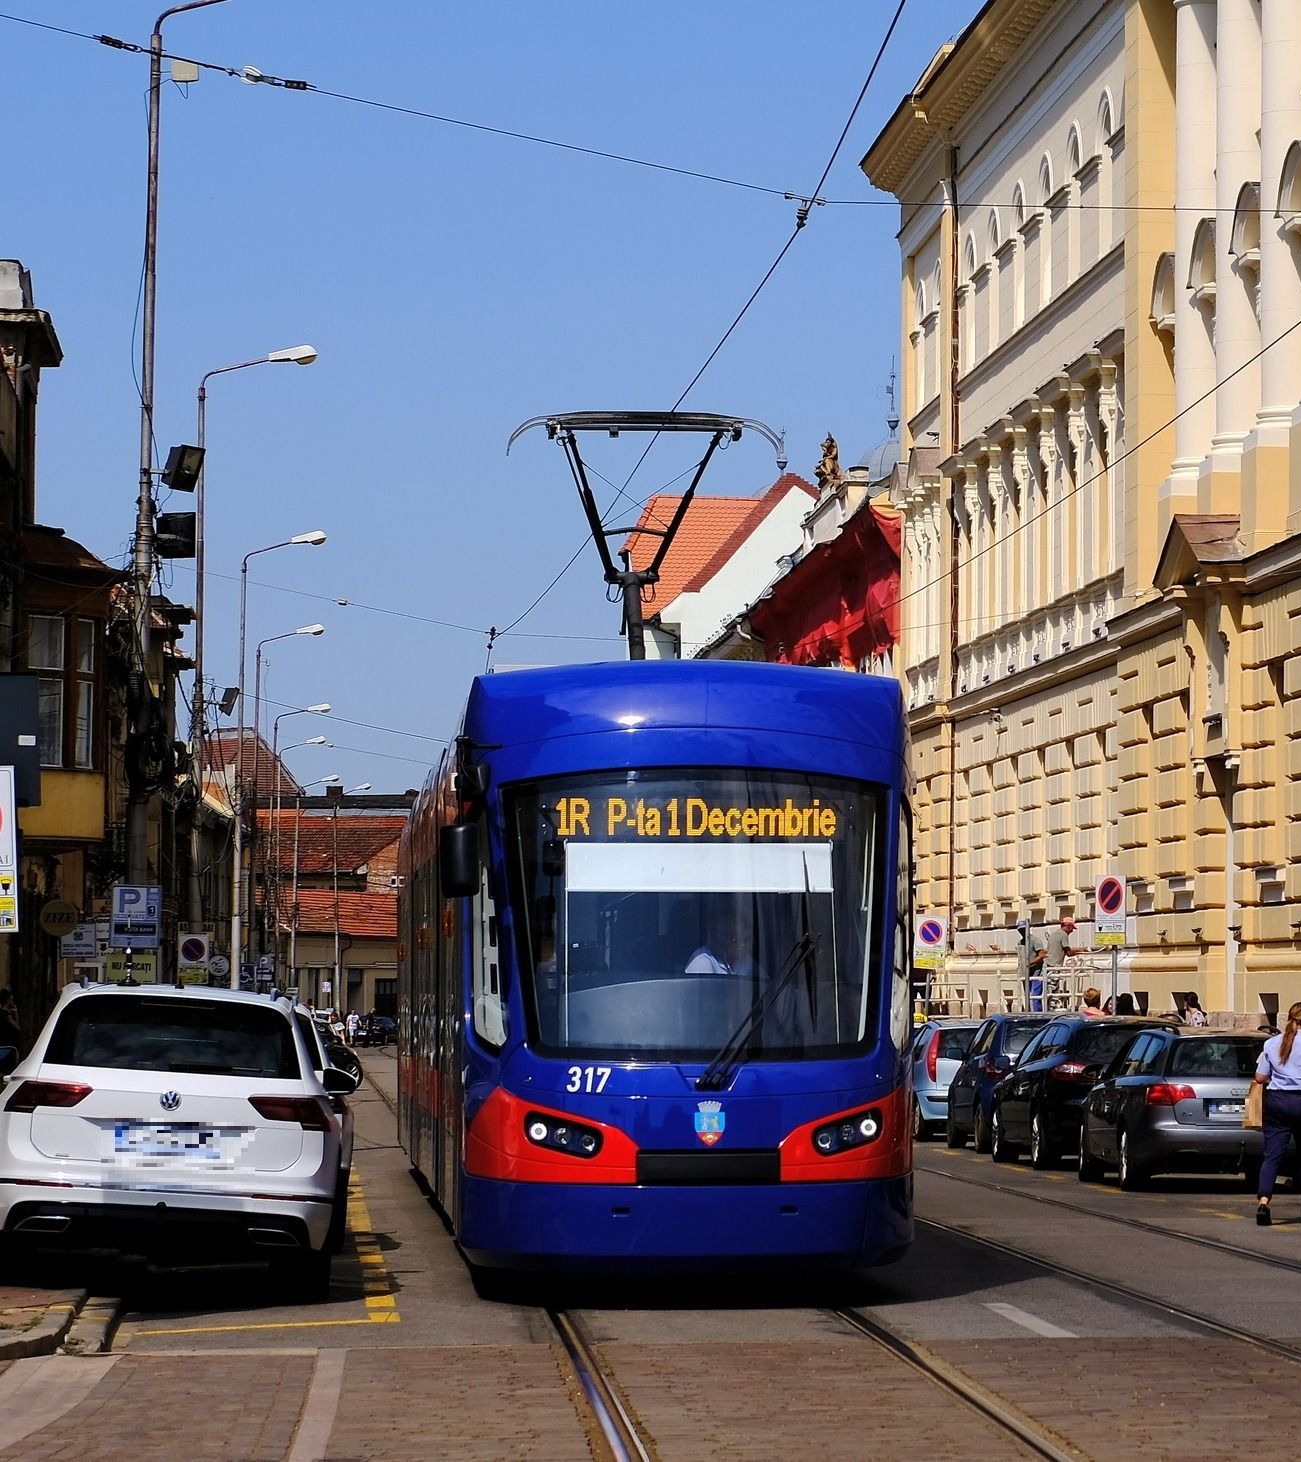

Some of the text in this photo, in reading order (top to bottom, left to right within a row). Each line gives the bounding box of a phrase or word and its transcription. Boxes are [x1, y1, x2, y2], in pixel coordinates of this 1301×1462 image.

[555, 797, 837, 836] 1R P-ta 1 Decembrie
[119, 889, 141, 913] P
[111, 962, 152, 973] NU PRCAȚI
[566, 1066, 612, 1093] 317
